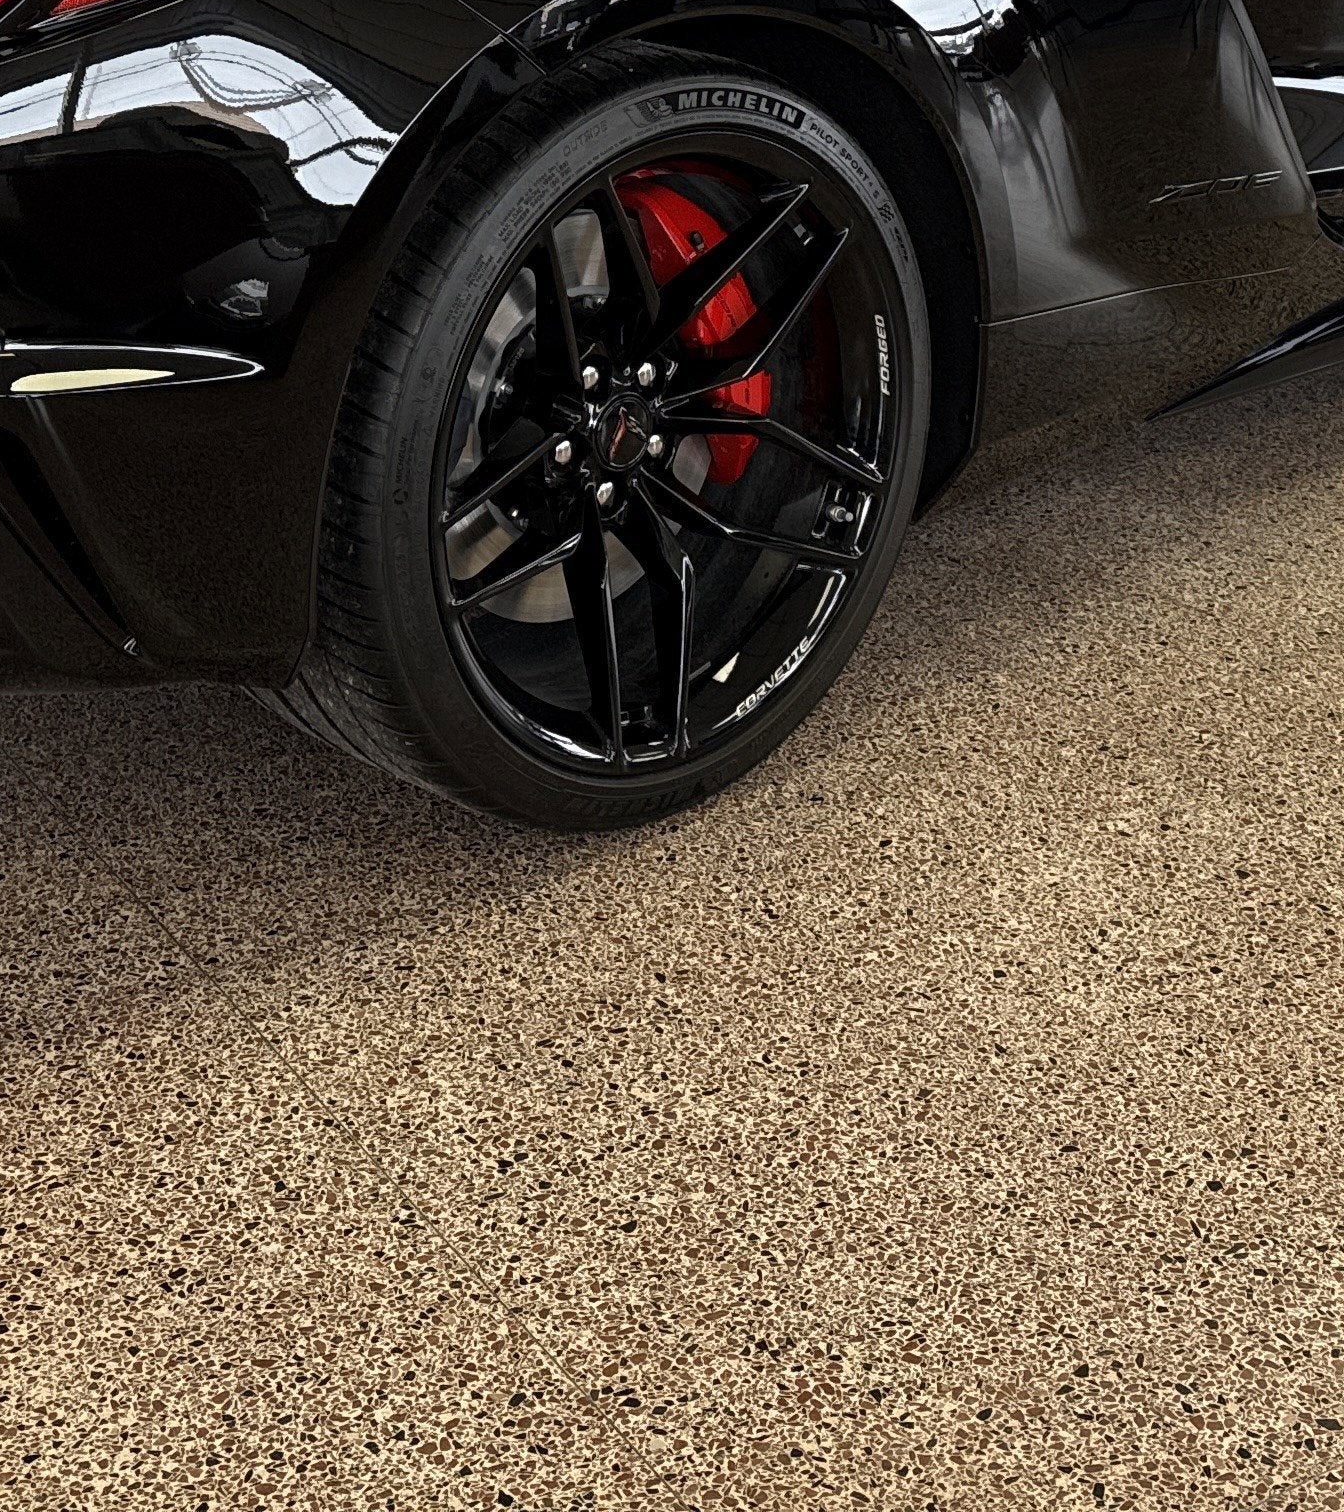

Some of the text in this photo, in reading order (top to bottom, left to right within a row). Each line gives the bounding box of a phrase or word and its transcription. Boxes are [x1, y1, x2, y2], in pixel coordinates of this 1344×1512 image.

[677, 89, 799, 124] MICHELIN
[809, 122, 840, 149] PILOT
[839, 147, 870, 182] SPORT
[873, 313, 892, 397] FORGED
[734, 635, 810, 718] CORVETTE
